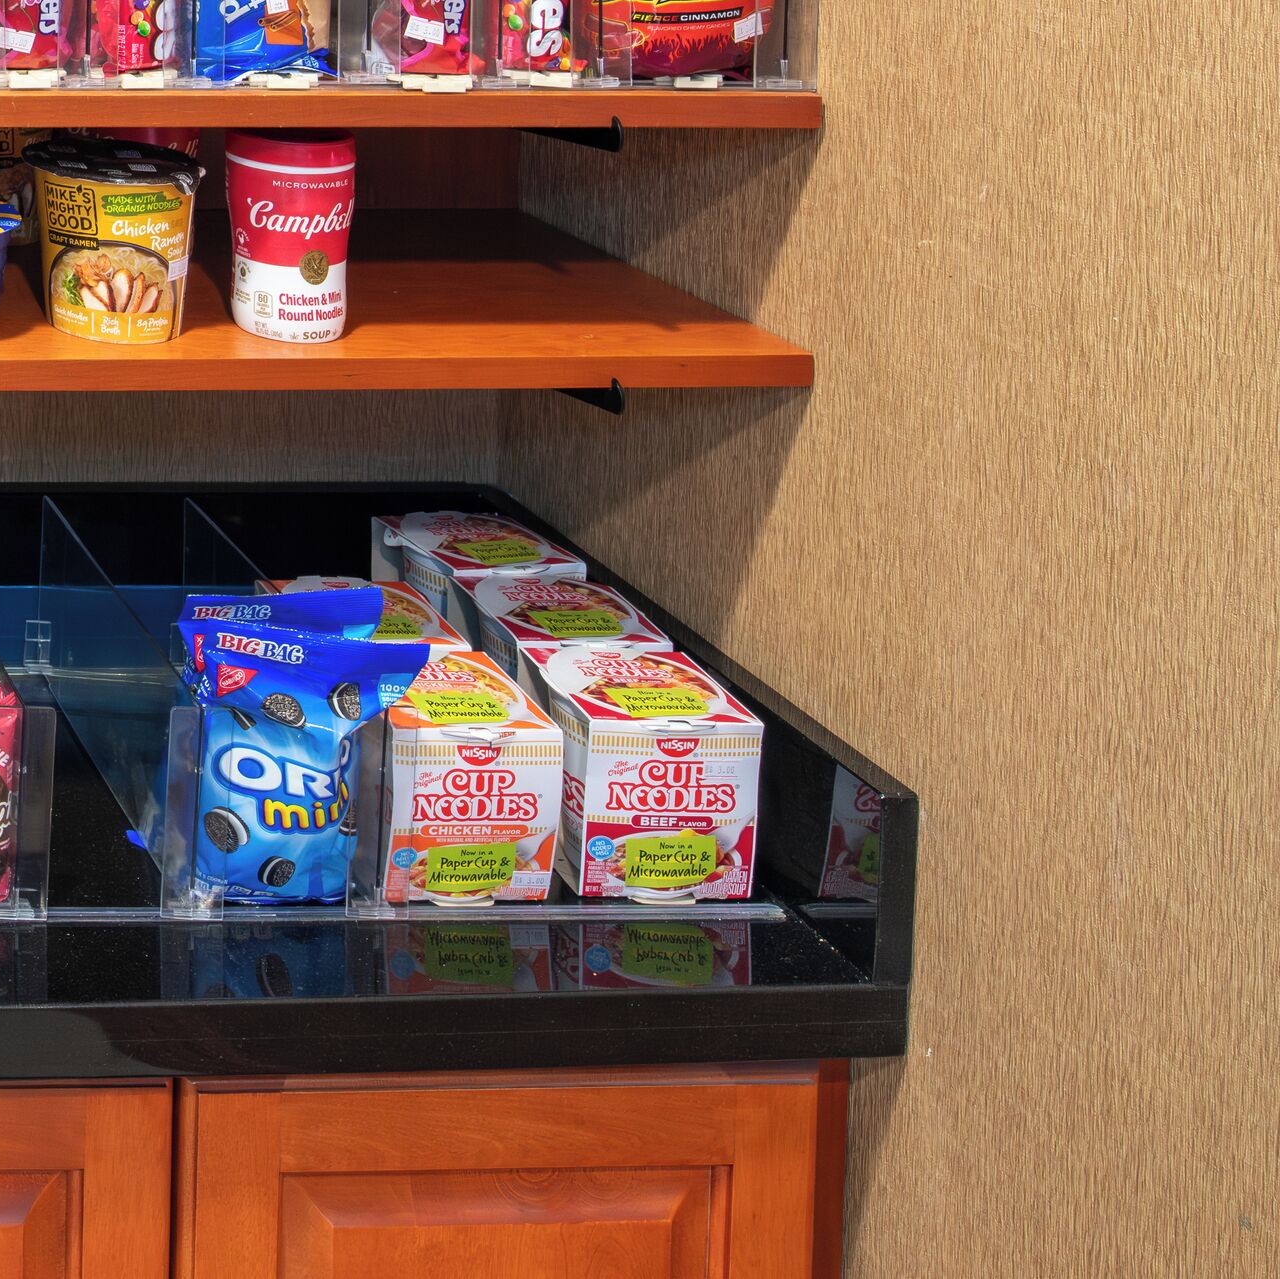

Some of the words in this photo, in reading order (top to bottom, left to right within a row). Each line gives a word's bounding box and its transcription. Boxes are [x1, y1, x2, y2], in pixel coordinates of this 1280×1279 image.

[633, 12, 679, 21] FIERCE
[680, 9, 740, 20] CINNAMON
[273, 179, 348, 188] MICROWAVABLE
[47, 185, 90, 203] MIKE'S
[48, 201, 92, 215] MIGHTY
[112, 219, 169, 237] Chicken
[217, 633, 259, 655] BIG
[263, 644, 303, 663] BAG
[660, 740, 694, 750] NISSIN
[444, 771, 515, 794] CUP
[641, 816, 677, 826] BEEF
[429, 826, 491, 835] CHICKEN
[629, 864, 708, 878] Microwavable
